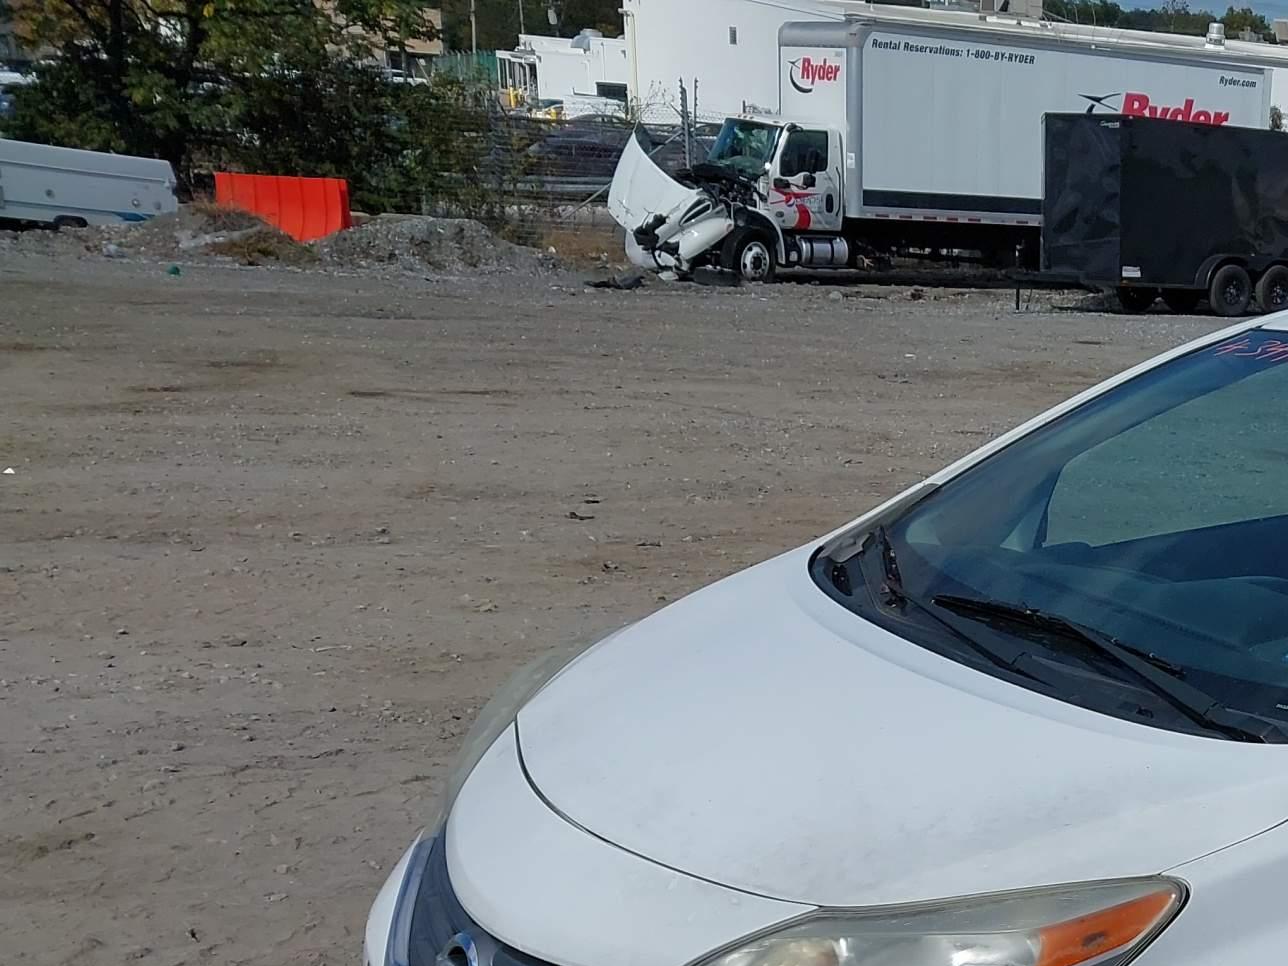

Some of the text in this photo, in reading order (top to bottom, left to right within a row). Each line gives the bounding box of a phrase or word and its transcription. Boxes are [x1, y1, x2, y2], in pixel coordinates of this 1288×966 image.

[871, 38, 1036, 65] Rental Reservations: 1-800-BY-RYDER
[800, 57, 841, 86] Ryder
[1219, 75, 1257, 89] Ryder.com
